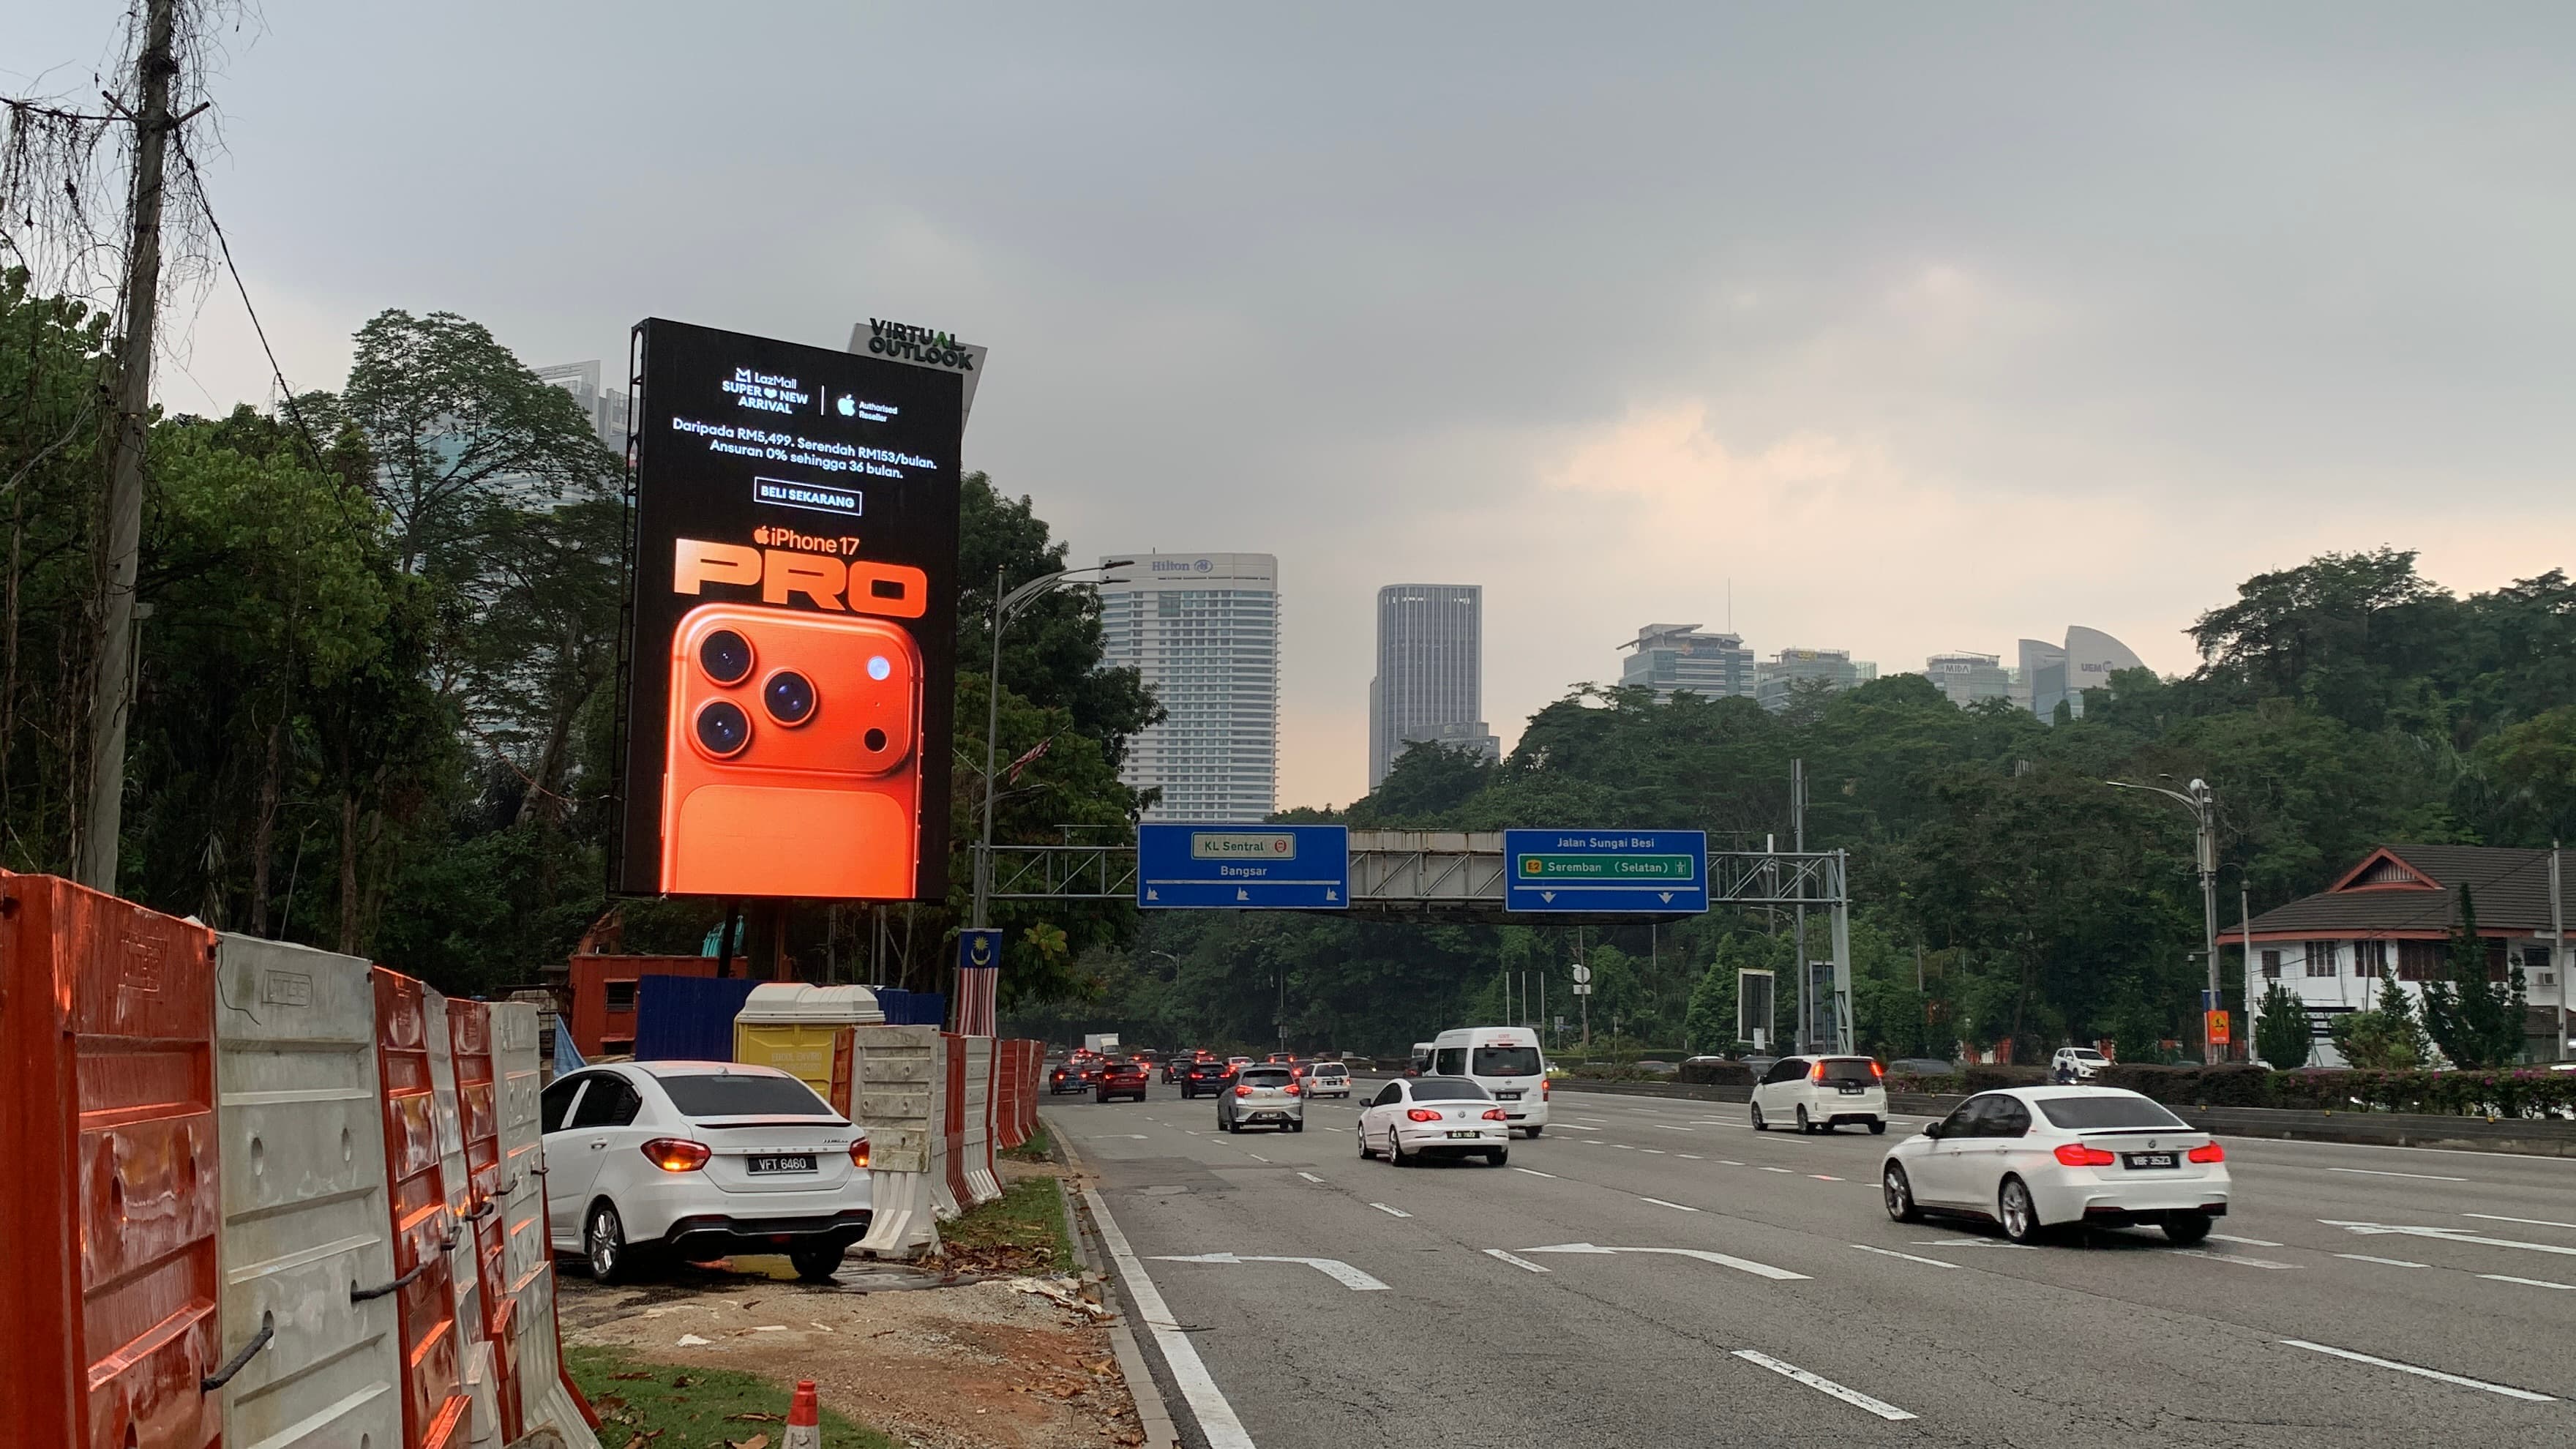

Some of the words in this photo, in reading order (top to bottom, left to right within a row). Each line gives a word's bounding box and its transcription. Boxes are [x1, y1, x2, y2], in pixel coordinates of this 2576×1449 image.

[869, 318, 966, 351] VIRTUAL
[869, 336, 973, 370] OUTLOOK
[755, 372, 797, 389] LazMall
[722, 381, 762, 397] SUPER
[780, 391, 808, 405] NEW
[738, 395, 793, 415] ARRIVAL
[858, 401, 898, 415] Authorised
[858, 411, 887, 423] Reseller
[673, 417, 734, 438] Daripada
[737, 427, 795, 448] RM5,499.
[798, 437, 855, 457] Serendah
[858, 446, 937, 470] RM153/bulan.
[710, 439, 763, 458] Ansuran
[766, 447, 787, 461] 0%
[790, 452, 847, 471] sehingga
[849, 460, 864, 473] 36
[866, 464, 904, 479] bulan.
[761, 485, 786, 499] BELI
[788, 489, 855, 508] SEKARANG
[771, 528, 837, 553] iPhone
[839, 536, 860, 555] 17
[1152, 560, 1190, 572] Hilton
[674, 538, 927, 618] PRO
[1945, 664, 1969, 674] MIDA
[2081, 662, 2102, 673] UEM
[1205, 842, 1219, 852] KL
[1223, 841, 1264, 852] Sentral
[1557, 837, 1586, 847] Jalan
[1590, 837, 1628, 850] Sungai
[1631, 838, 1655, 848] Besi
[1220, 865, 1268, 877] Bangsar
[1527, 861, 1540, 872] E2
[1548, 862, 1601, 872] Seremban
[1614, 861, 1669, 874] (Selatan)
[759, 1158, 777, 1169] VFT
[781, 1158, 806, 1169] 6460
